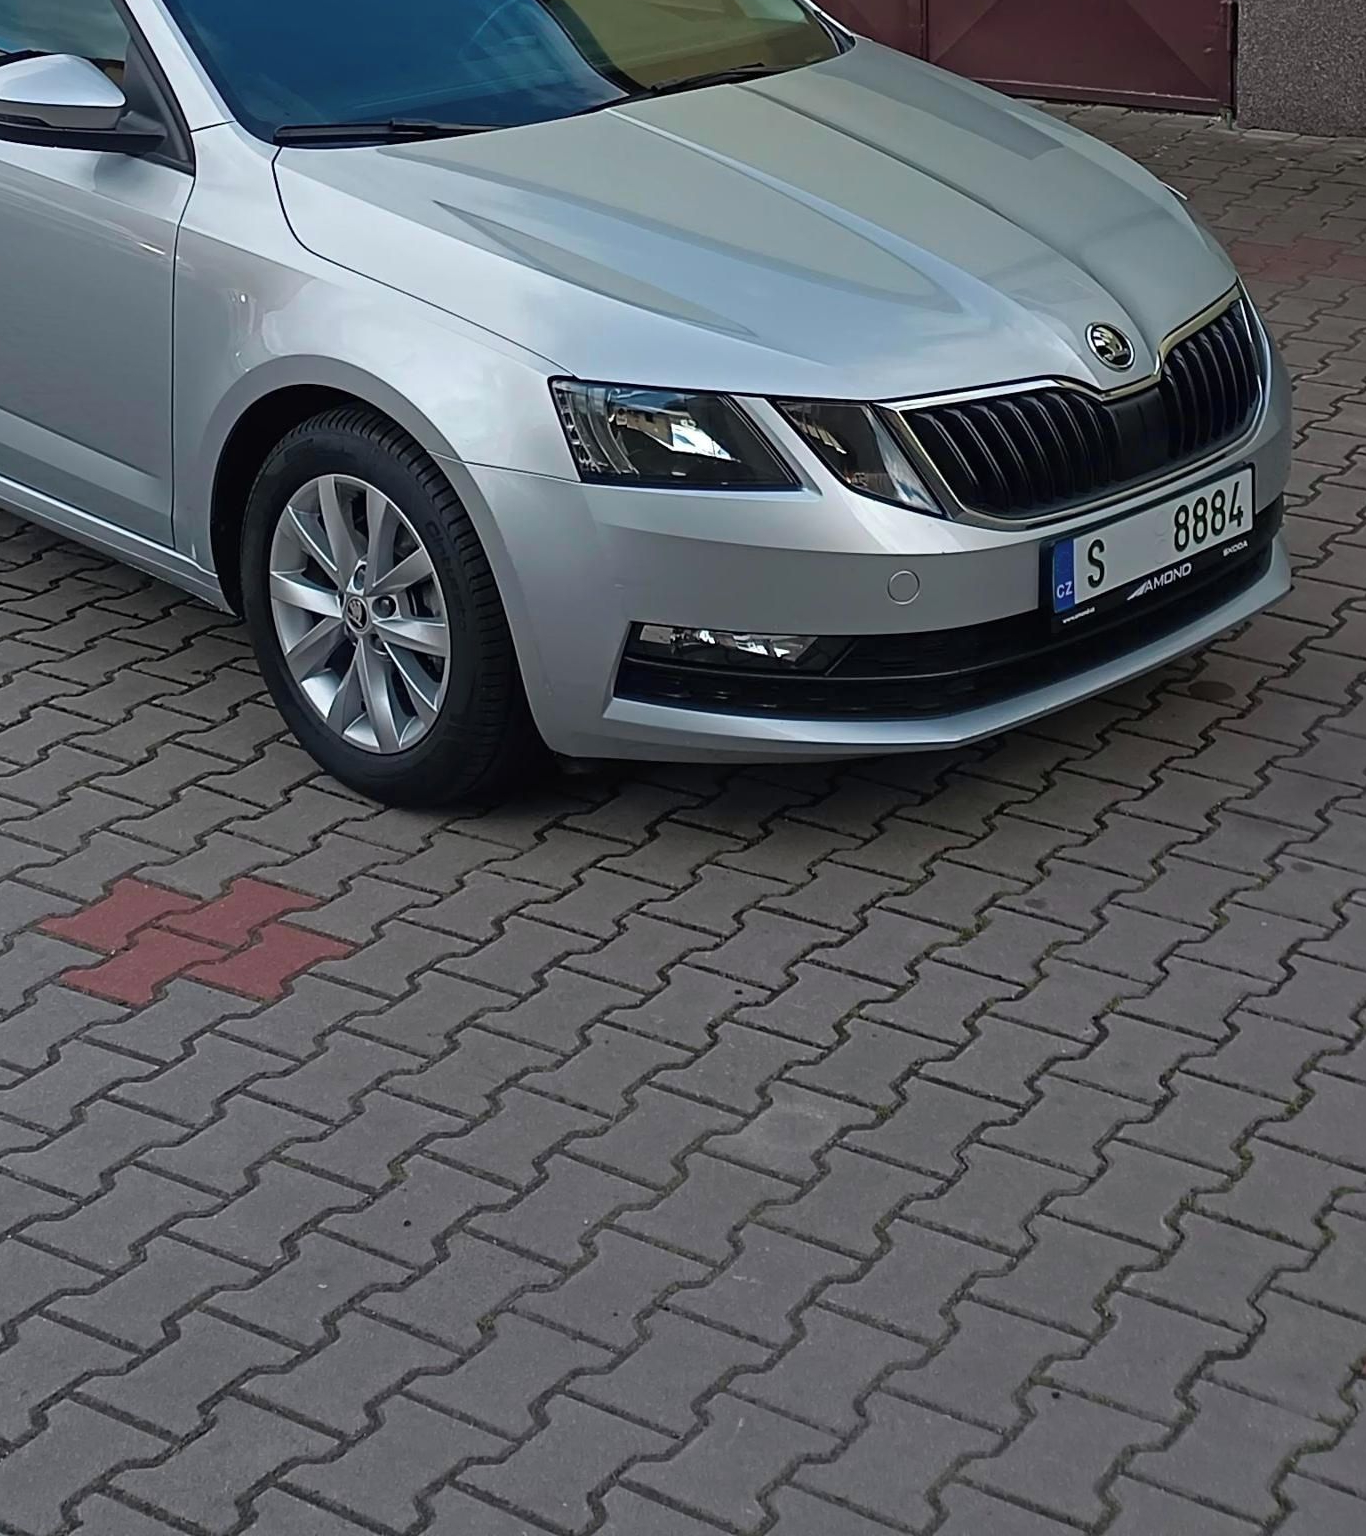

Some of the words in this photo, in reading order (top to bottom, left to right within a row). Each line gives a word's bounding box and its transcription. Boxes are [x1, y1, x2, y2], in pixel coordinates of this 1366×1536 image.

[1087, 539, 1106, 588] S
[1174, 481, 1245, 552] 8884
[1056, 581, 1073, 598] CZ
[1141, 562, 1192, 592] AMOND
